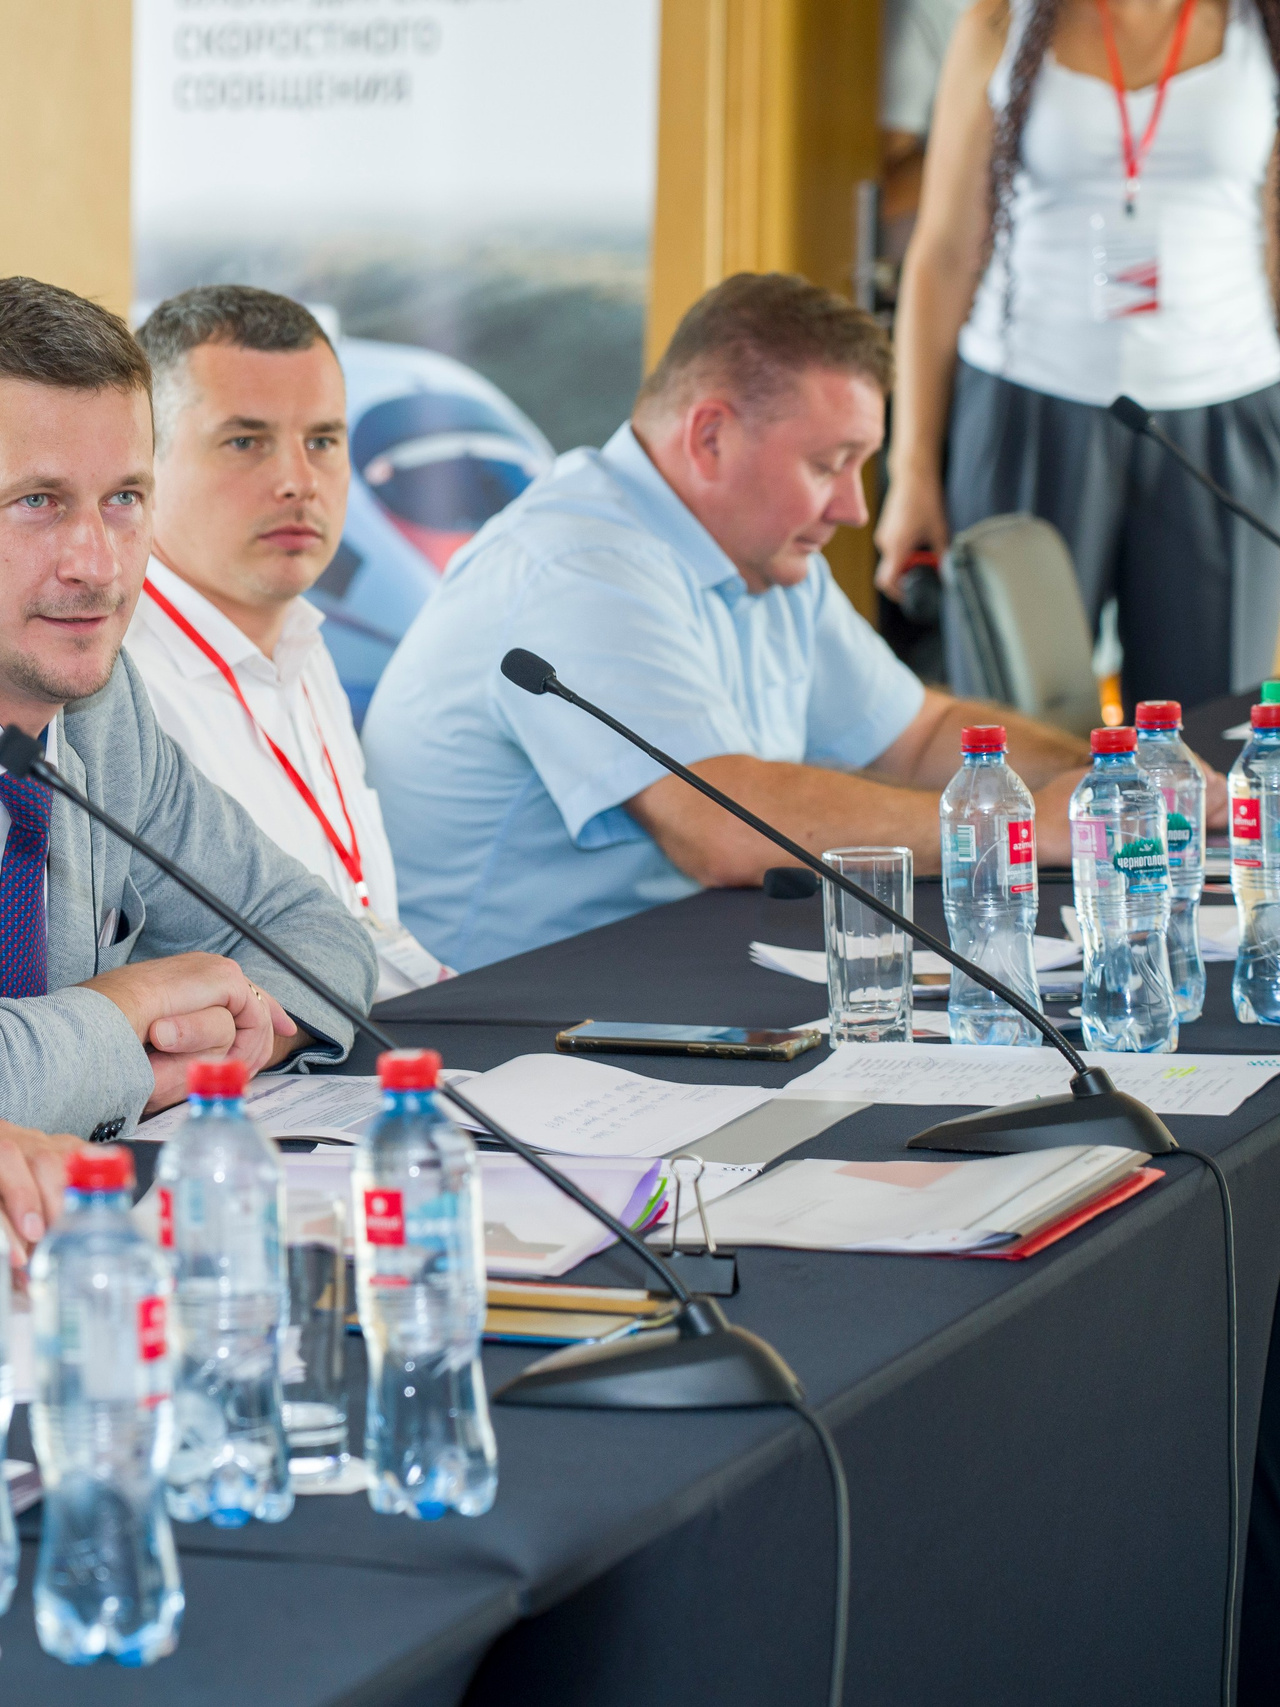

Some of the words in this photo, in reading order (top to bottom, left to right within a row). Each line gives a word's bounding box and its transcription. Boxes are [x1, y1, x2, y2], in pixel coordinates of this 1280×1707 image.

[175, 17, 441, 60] СКОРОСТНОГО
[1012, 841, 1033, 851] azimu
[1117, 855, 1167, 870] черноголов
